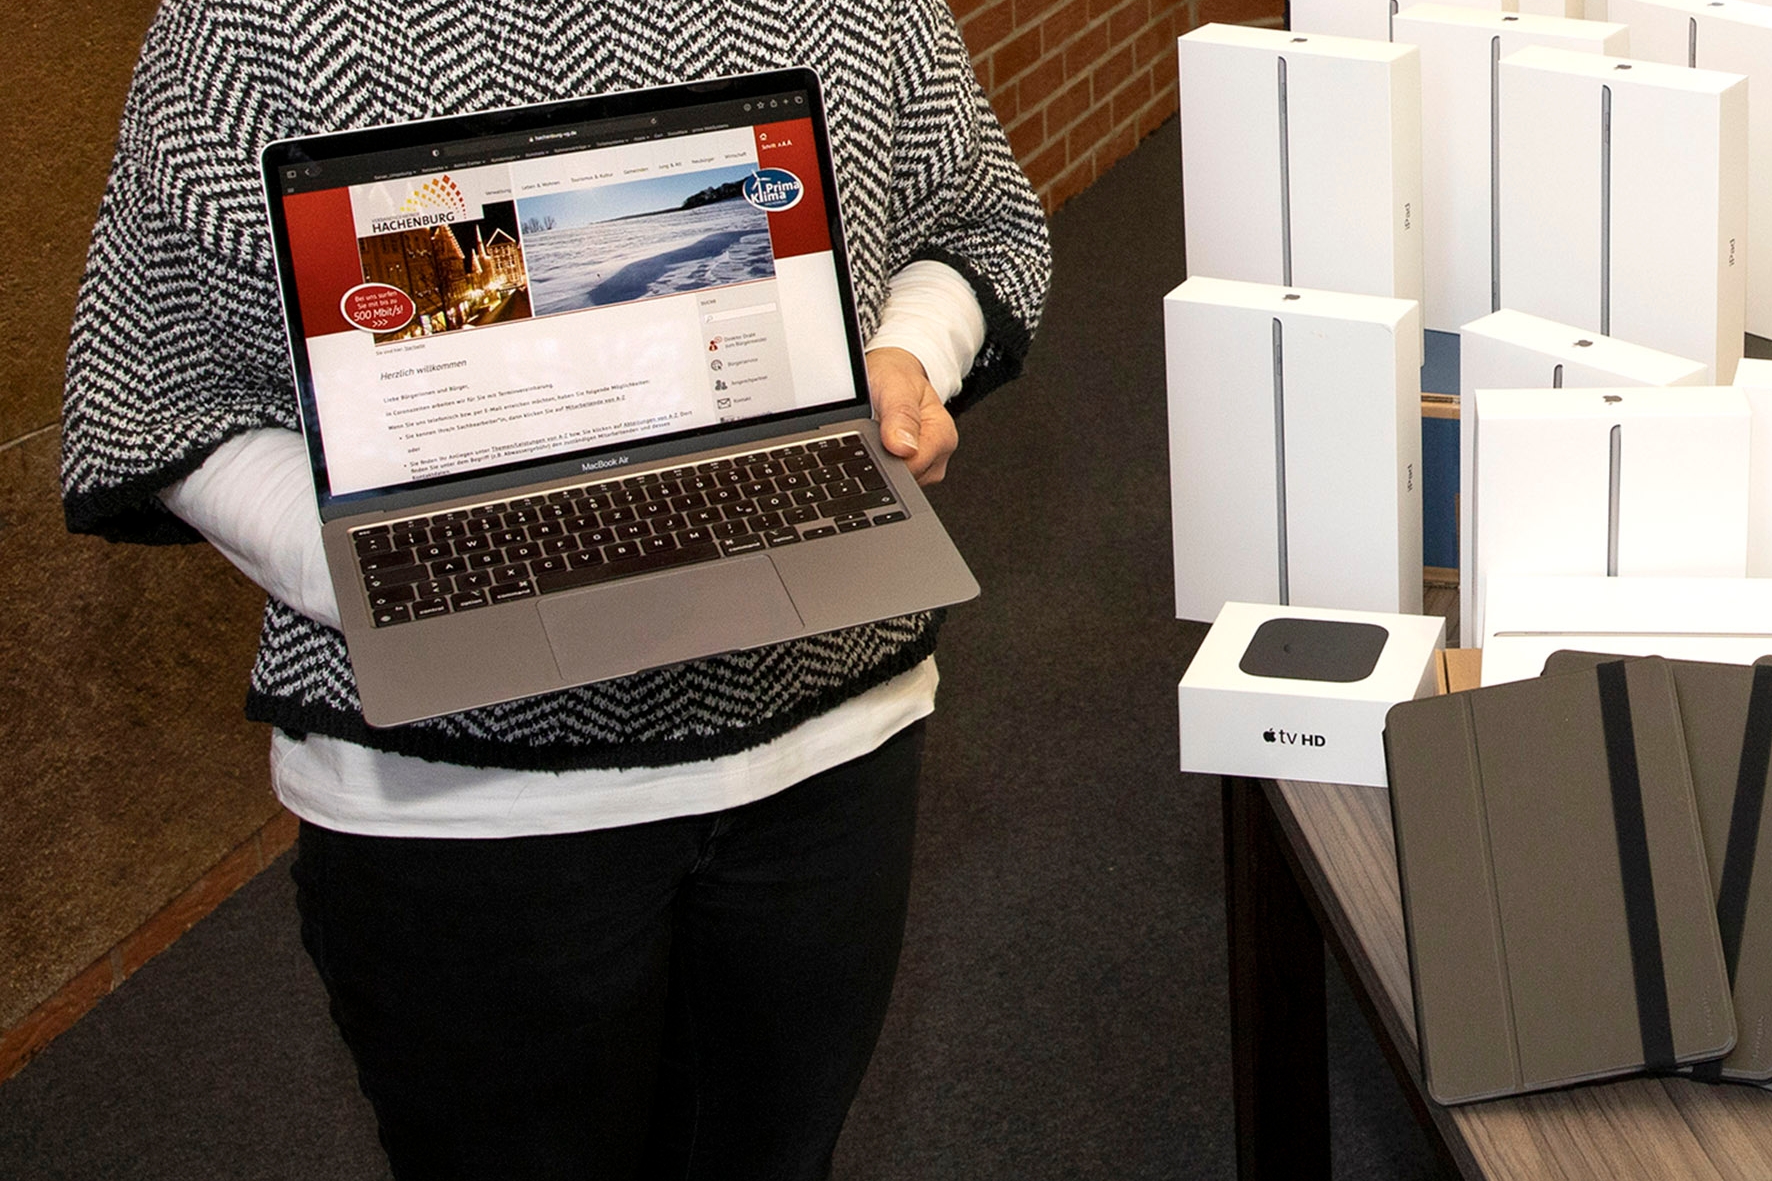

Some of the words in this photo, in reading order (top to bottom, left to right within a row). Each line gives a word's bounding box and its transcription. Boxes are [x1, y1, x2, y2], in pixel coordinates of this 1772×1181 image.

[765, 177, 800, 193] Prima
[749, 188, 786, 204] Klima
[371, 211, 455, 233] HACHENBURG
[377, 290, 397, 298] surfen
[379, 298, 389, 306] bis
[353, 310, 372, 321] 500
[372, 304, 404, 319] Mbit/s!
[379, 367, 414, 381] Herzlich
[416, 358, 467, 374] willkommen
[383, 395, 399, 404] Liebe
[400, 389, 435, 400] Bürgerinnen
[388, 423, 404, 431] Wenn
[427, 413, 459, 424] telefonisch
[484, 405, 502, 413] E-Mail
[503, 400, 530, 410] erreichen
[557, 392, 574, 400] haben
[585, 386, 610, 395] folgende
[392, 404, 430, 416] Coronazeiten
[431, 399, 455, 409] arbeiten
[415, 429, 436, 437] kennen
[523, 409, 543, 418] klicken
[564, 398, 603, 410] Mitarbeitende
[420, 457, 437, 465] finden
[448, 450, 473, 460] Anliegen
[475, 447, 490, 455] unter
[546, 434, 557, 442] von
[592, 424, 612, 433] klicken
[410, 466, 429, 474] finden
[470, 454, 489, 463] Begriff
[563, 434, 596, 445] zuständigen
[581, 458, 617, 471] MacBook
[618, 455, 629, 464] Air
[495, 588, 531, 599] command
[1279, 729, 1297, 745] tv
[1302, 734, 1326, 747] HD
